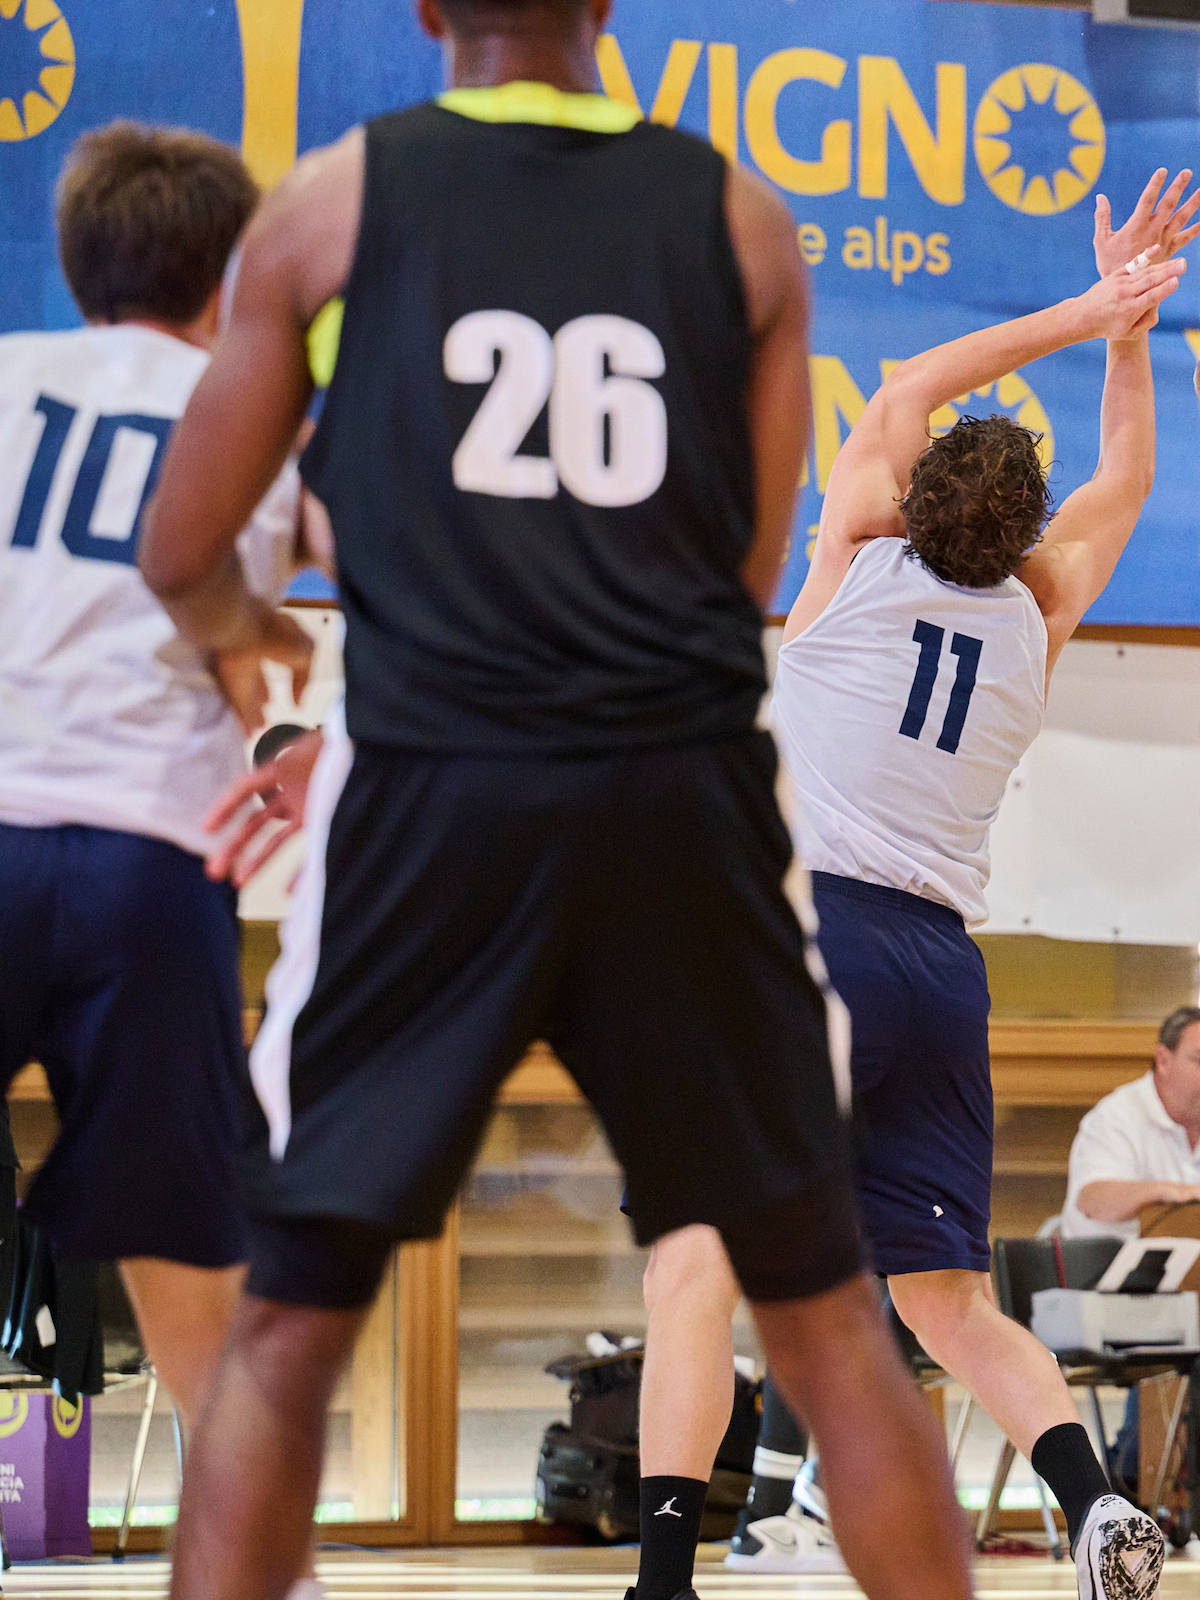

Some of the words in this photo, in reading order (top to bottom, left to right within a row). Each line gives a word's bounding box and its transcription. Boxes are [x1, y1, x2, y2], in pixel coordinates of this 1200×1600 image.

[594, 33, 1106, 216] VIGNO
[842, 216, 952, 285] alps
[11, 391, 176, 567] 10
[443, 309, 668, 507] 26
[898, 618, 984, 756] 11
